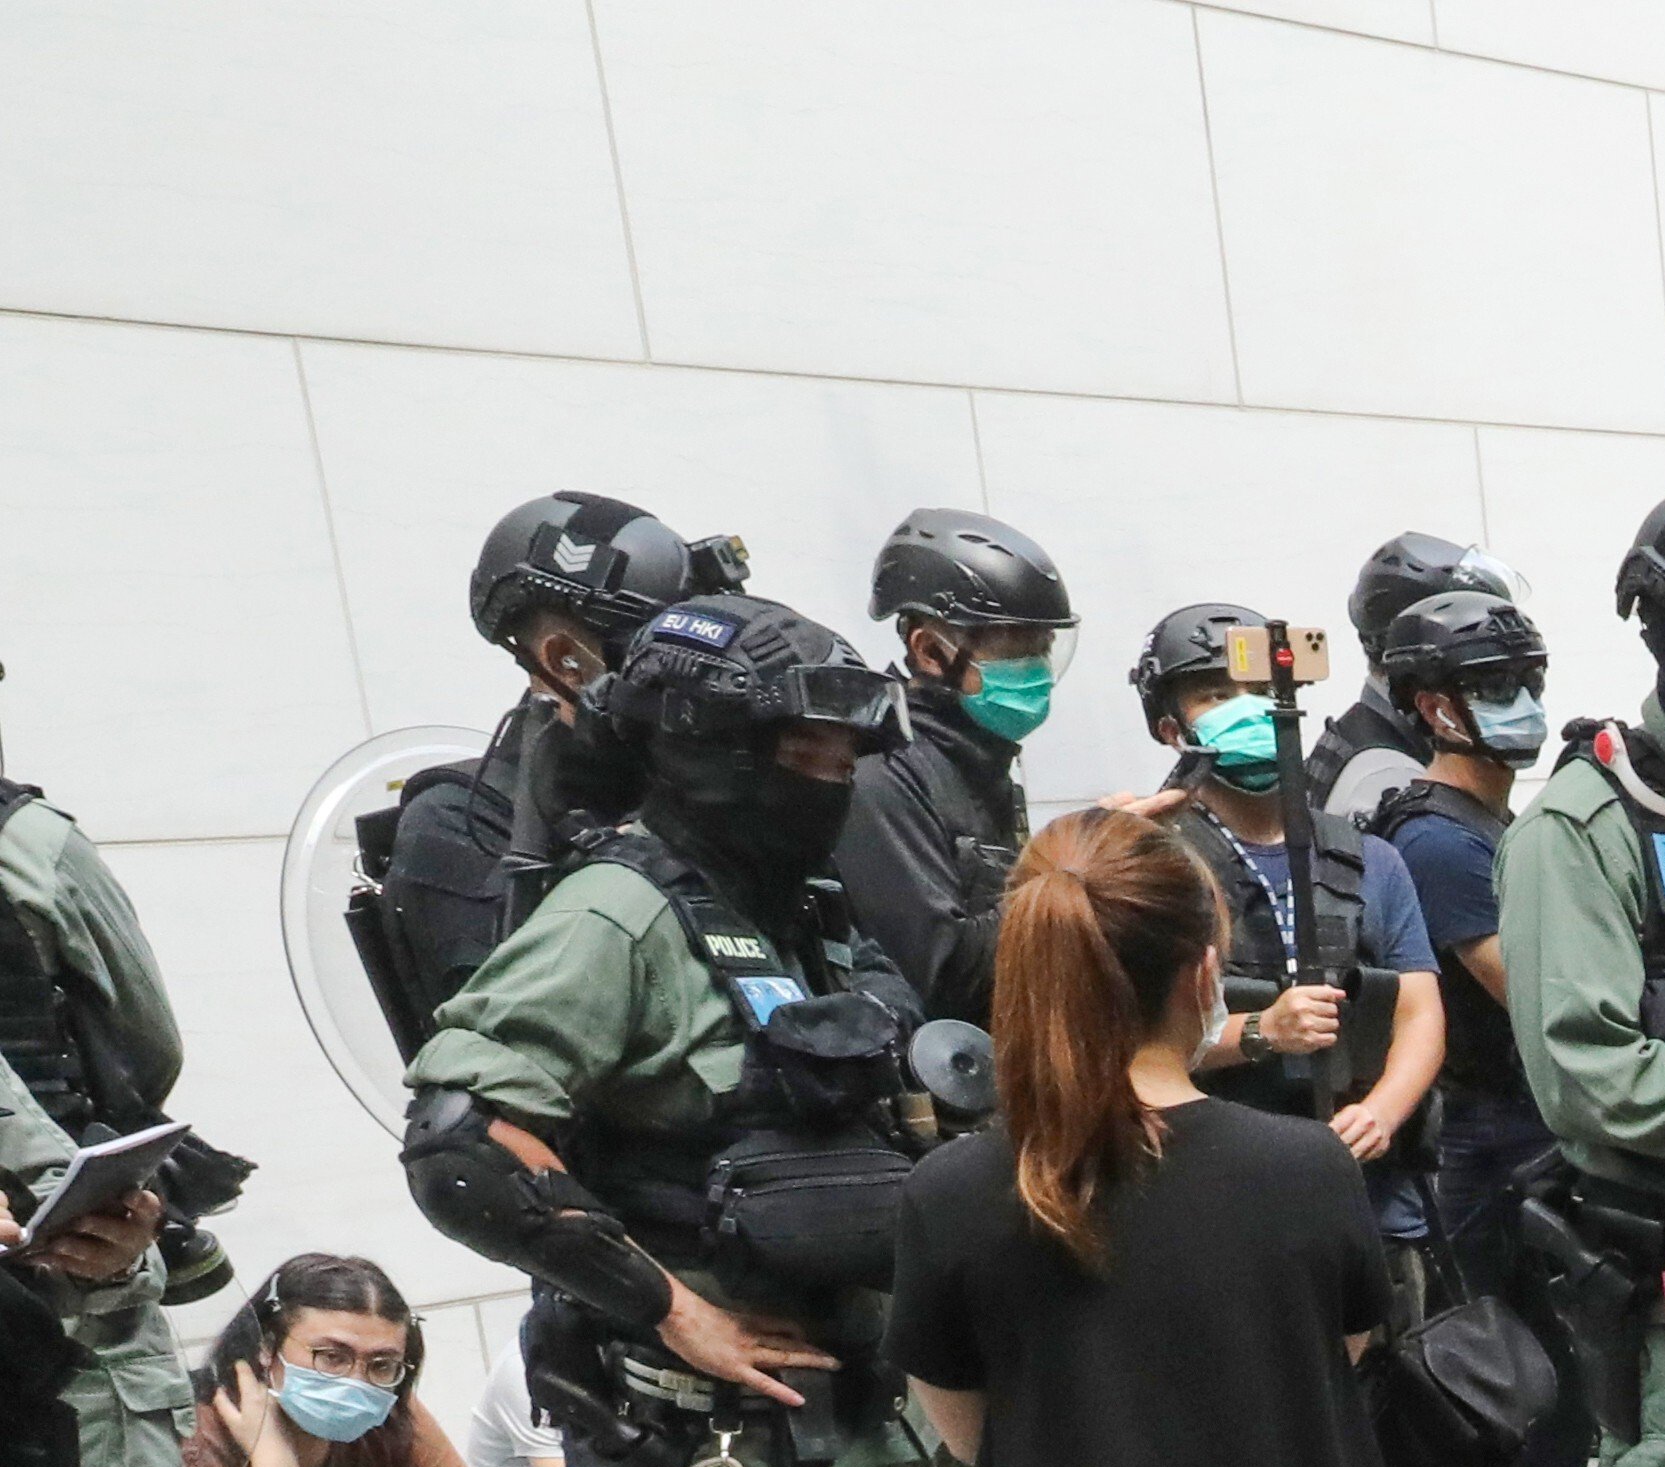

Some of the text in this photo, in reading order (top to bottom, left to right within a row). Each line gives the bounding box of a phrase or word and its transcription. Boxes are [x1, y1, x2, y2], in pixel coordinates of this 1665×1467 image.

[662, 613, 724, 640] EU HKI
[703, 933, 767, 960] POLICE
